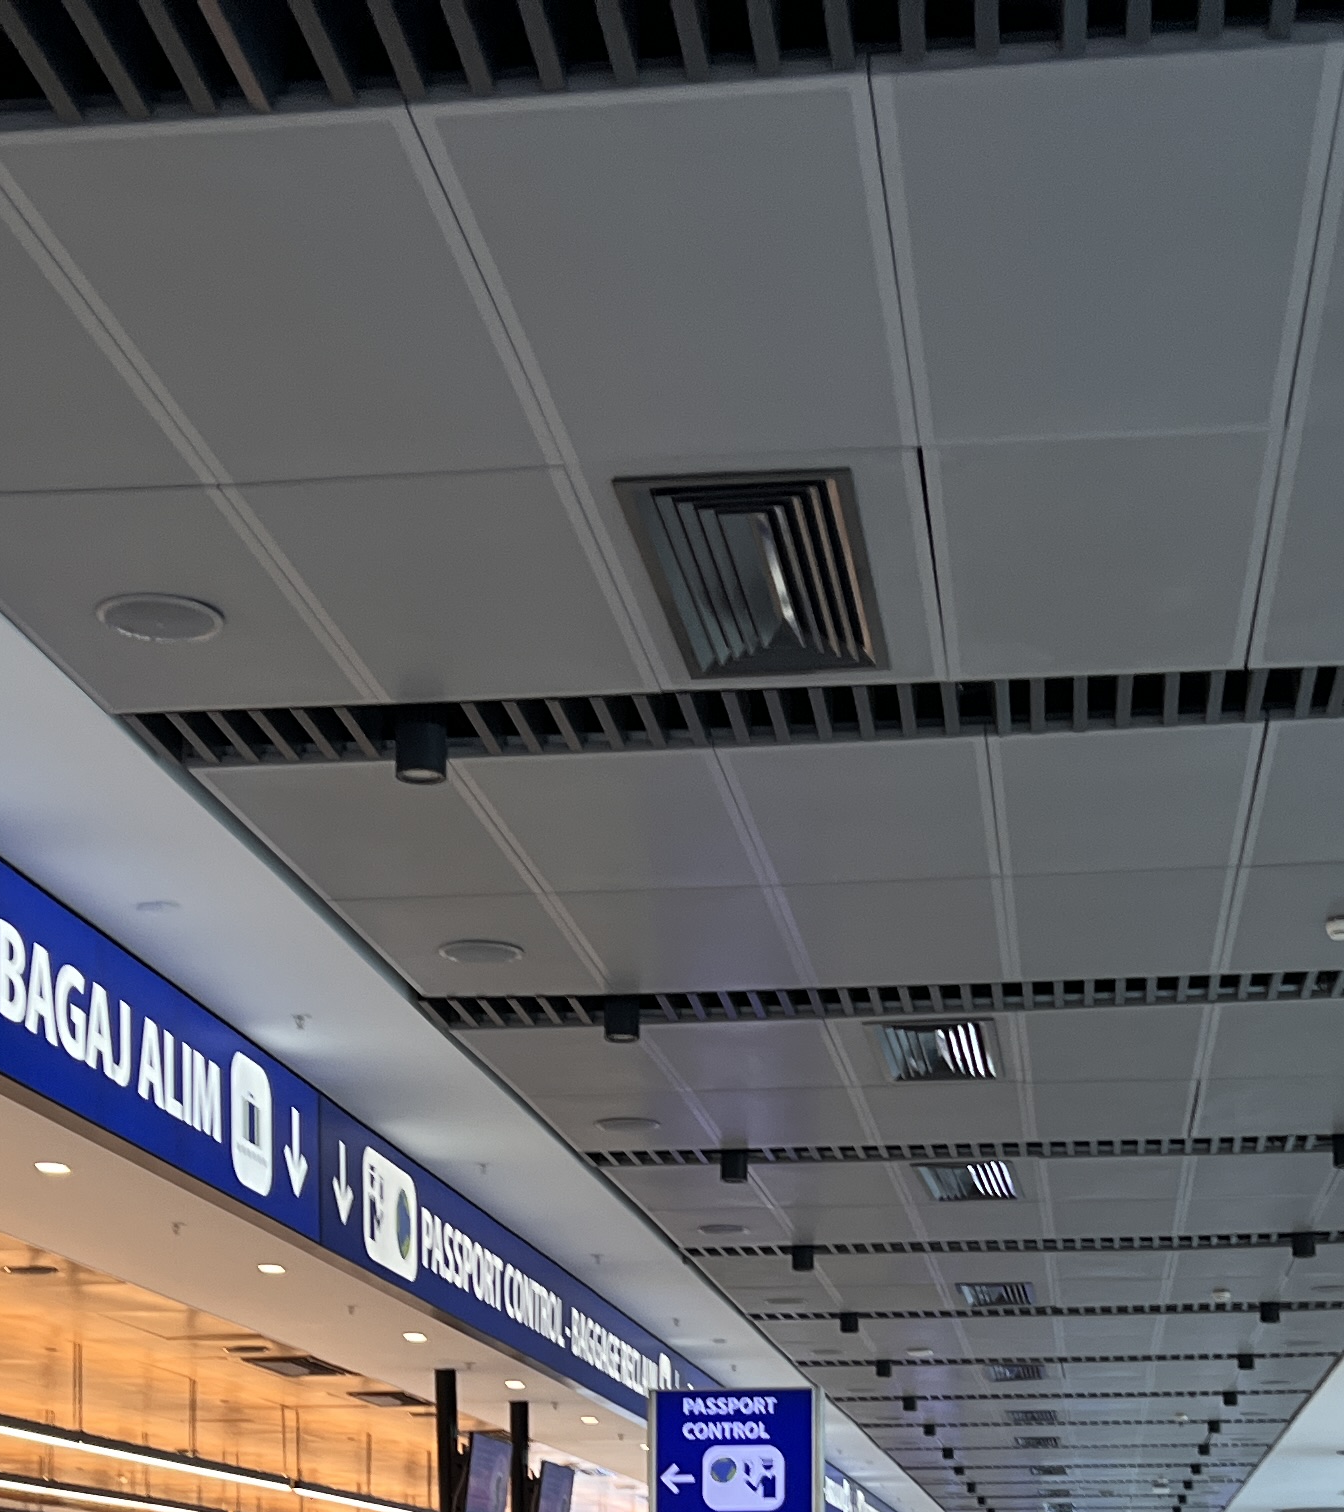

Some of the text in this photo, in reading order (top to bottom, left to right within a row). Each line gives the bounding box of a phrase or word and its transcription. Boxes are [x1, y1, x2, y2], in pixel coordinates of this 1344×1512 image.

[138, 1017, 222, 1144] ALIM
[421, 1206, 504, 1312] PASSPORT
[503, 1263, 566, 1349] CONTROL
[571, 1306, 621, 1383] BAGGAGE
[682, 1396, 777, 1416] PASSPORT
[682, 1420, 771, 1441] CONTROL
